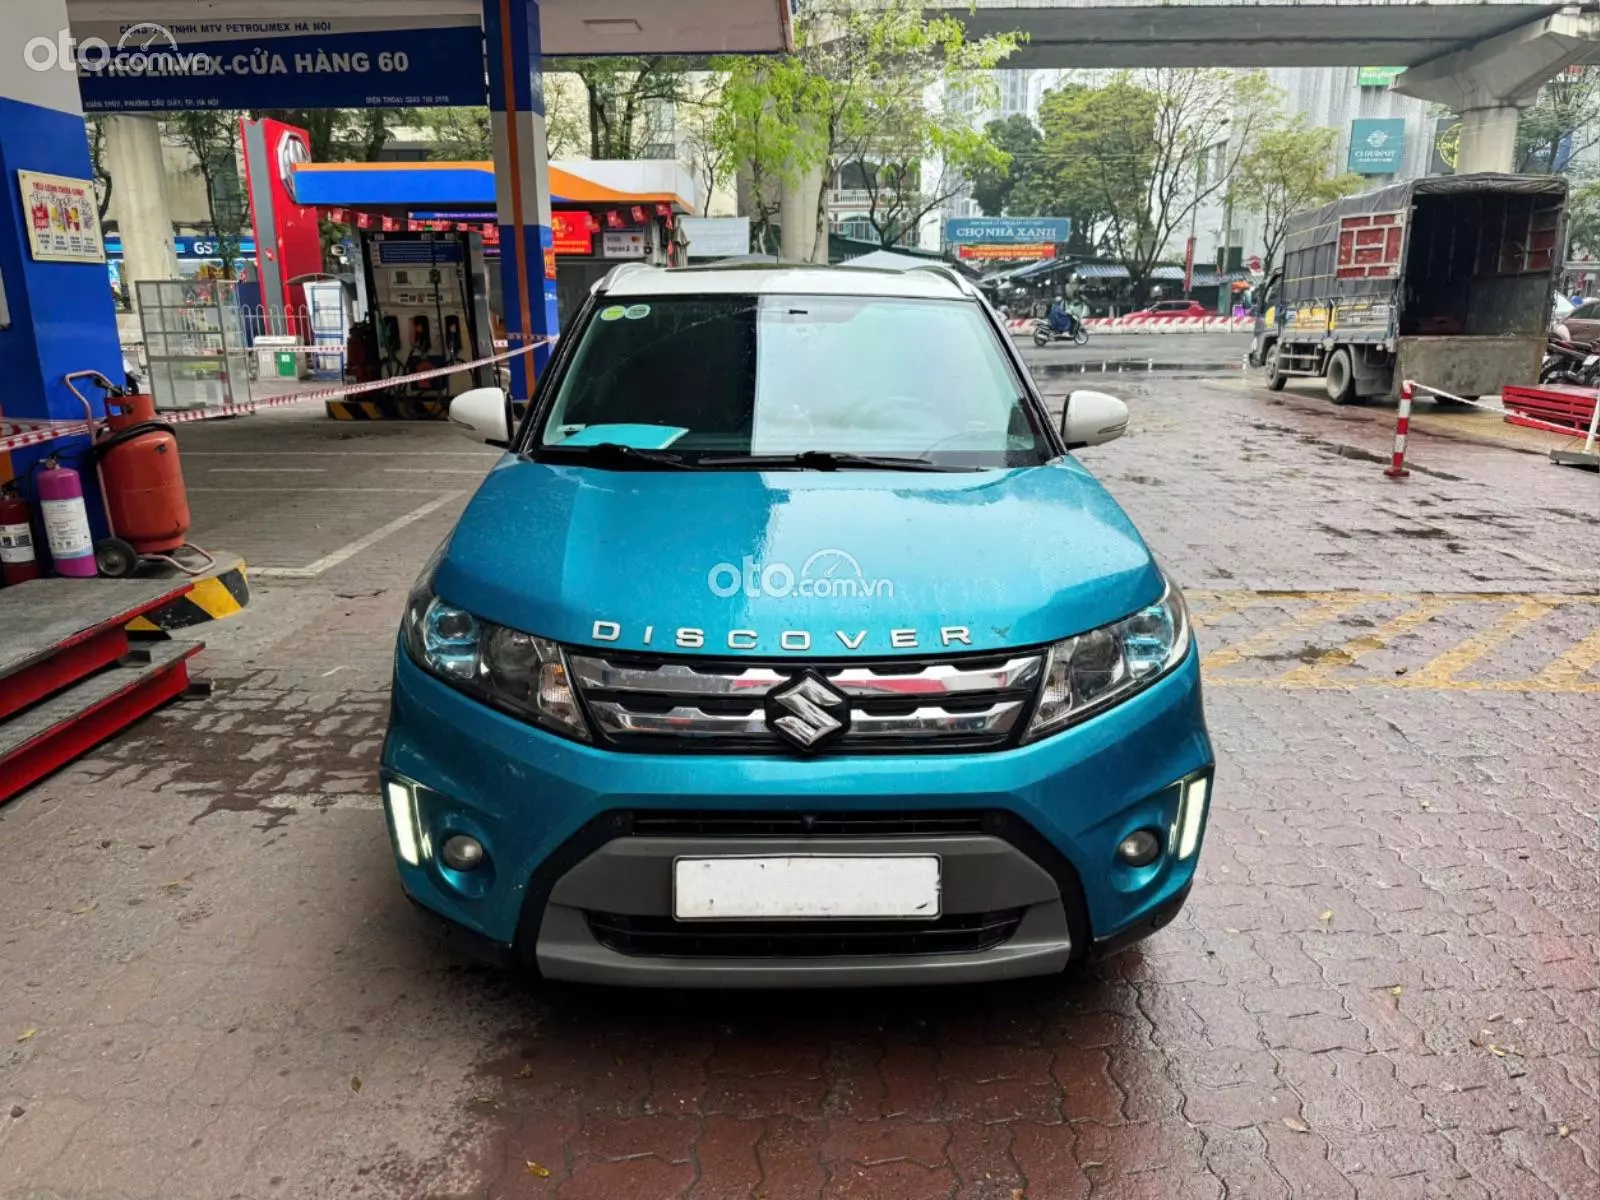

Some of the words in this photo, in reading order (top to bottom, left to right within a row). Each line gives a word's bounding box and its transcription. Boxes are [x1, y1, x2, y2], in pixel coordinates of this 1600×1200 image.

[170, 23, 196, 34] TNHH
[201, 23, 222, 33] MTV
[226, 21, 290, 33] PETROLIMEX
[294, 48, 371, 73] HÀNG
[378, 51, 409, 73] 60
[956, 226, 985, 238] CHỢ
[985, 223, 1014, 237] NHÀ
[1017, 227, 1057, 238] XANH
[591, 620, 973, 651] DISCOVER
